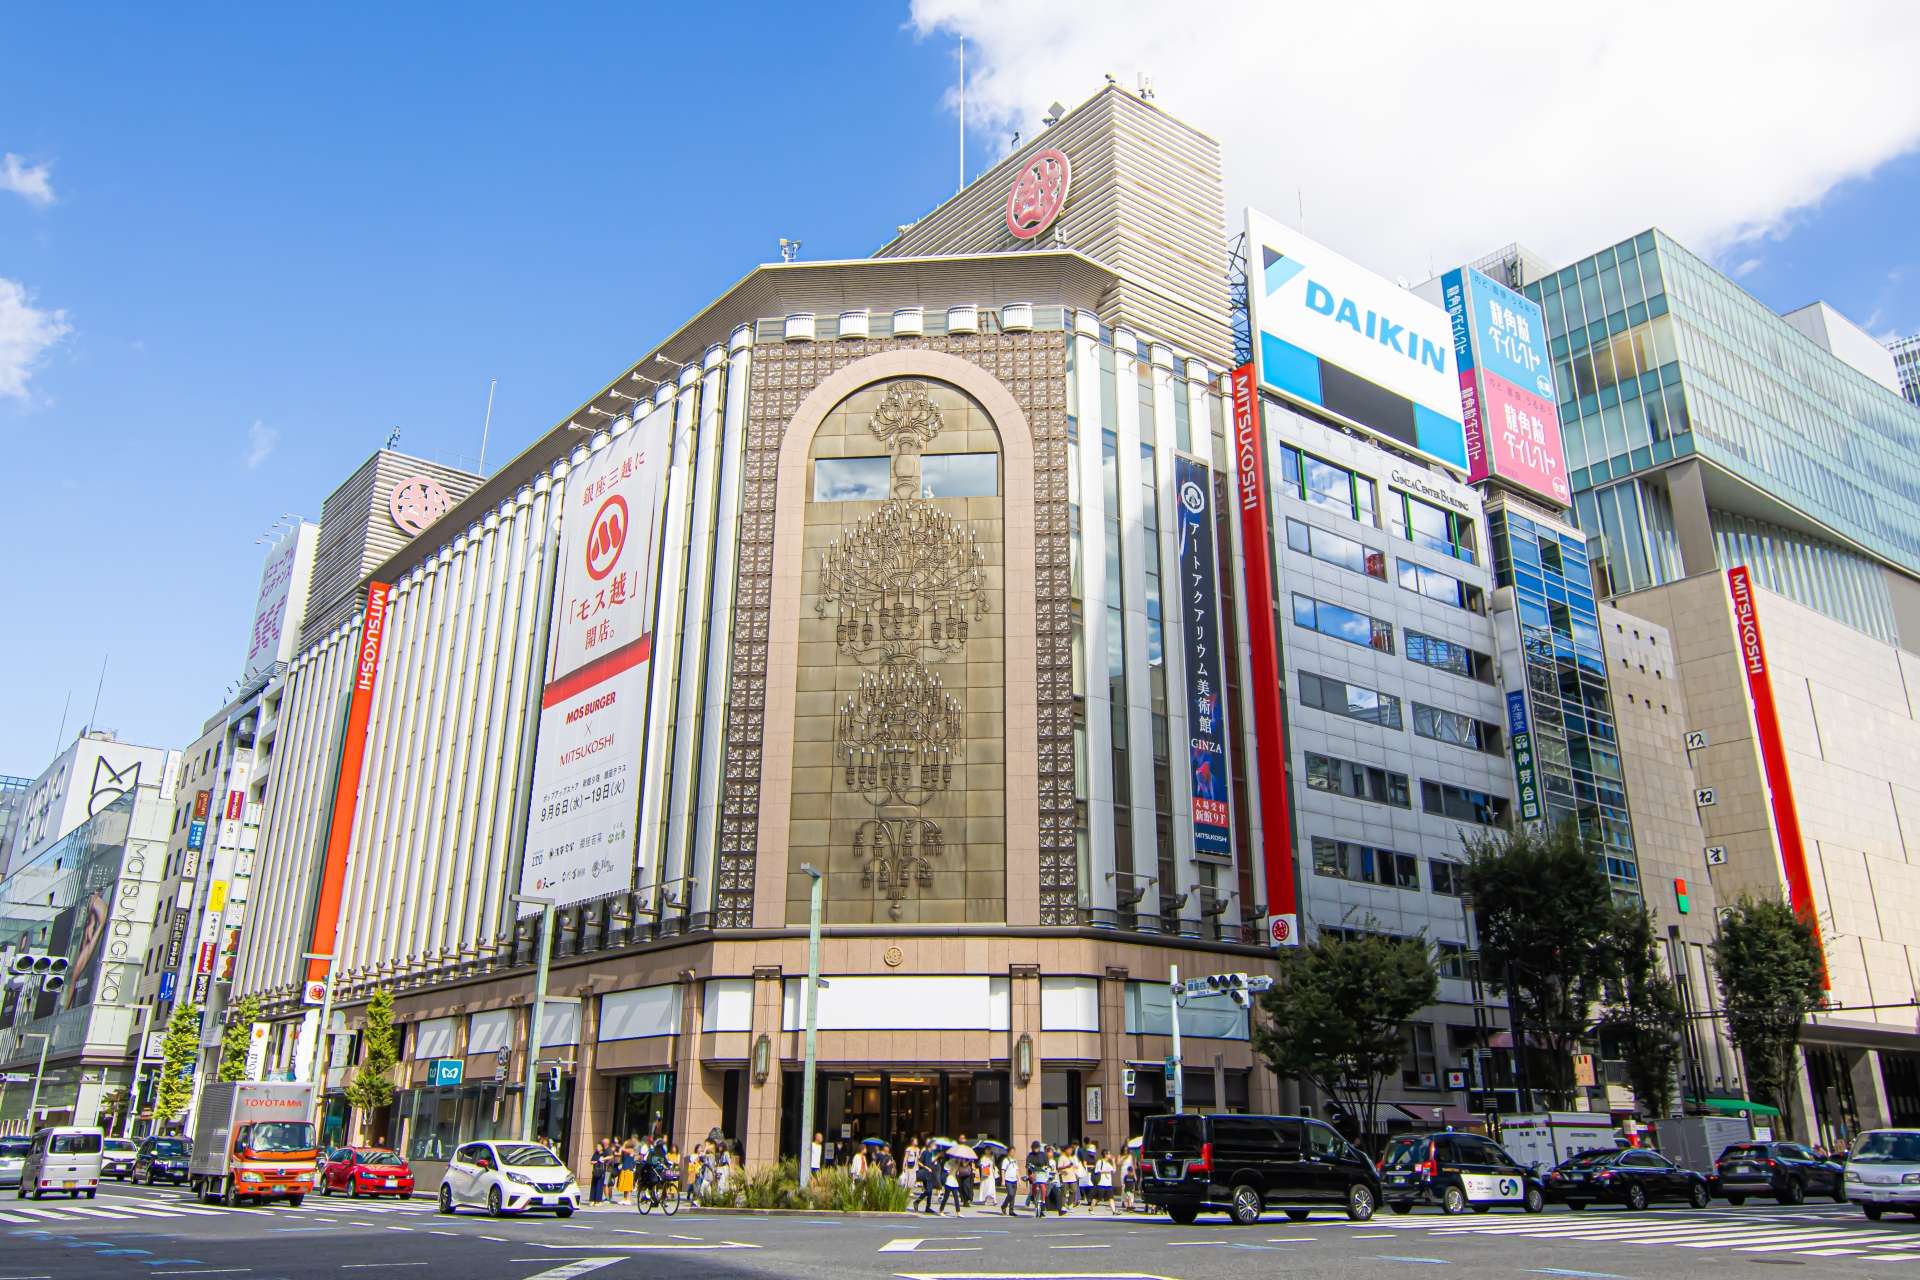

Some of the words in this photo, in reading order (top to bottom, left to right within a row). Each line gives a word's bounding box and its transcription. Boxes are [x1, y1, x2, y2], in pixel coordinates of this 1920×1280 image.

[1305, 279, 1445, 374] DAIKIN
[1236, 375, 1257, 511] MITSUKOSHI
[583, 452, 645, 506] 銀座三越に
[569, 571, 638, 625] 「モス越」
[1733, 574, 1762, 674] MITSUKOSHI
[358, 589, 387, 691] MITSUKOSHI
[585, 619, 615, 650] 開店。
[1189, 521, 1212, 734] アートアクアリウム美術館
[565, 706, 584, 725] MOS
[585, 691, 616, 717] BURGER
[560, 733, 614, 767] MITSUKOSHI
[1191, 738, 1222, 754] GINZA
[1195, 832, 1227, 843] MITSUKOSHI
